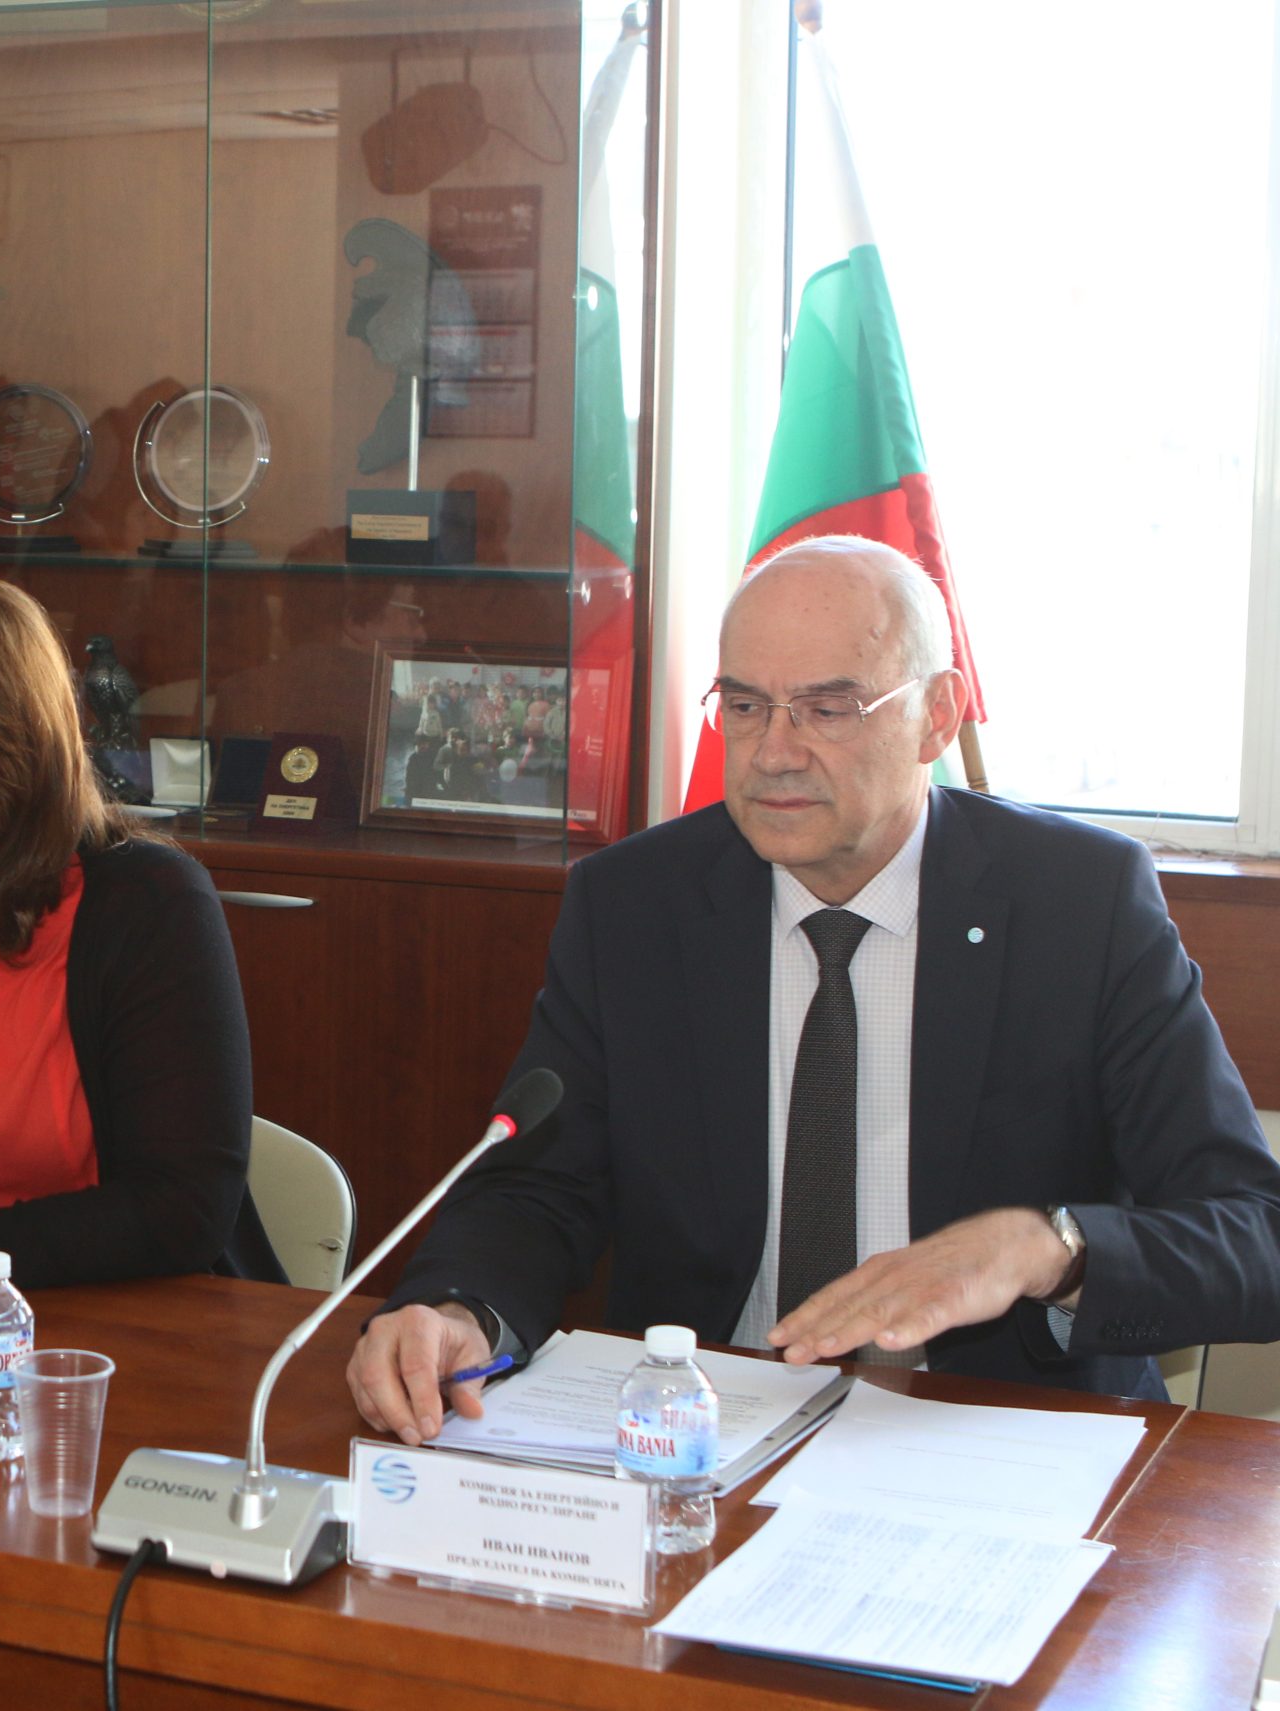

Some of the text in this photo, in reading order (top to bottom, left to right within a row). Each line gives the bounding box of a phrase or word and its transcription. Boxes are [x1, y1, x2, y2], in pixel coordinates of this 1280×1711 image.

[125, 1476, 217, 1502] GONSIN
[459, 1478, 517, 1497] КОМИСИЯ
[520, 1488, 533, 1500] ЗА
[482, 1538, 591, 1566] ИВАН ИВАНОВ
[447, 1553, 627, 1591] ПРЕДСЕДАТЕЛ НА КОМИСИЯТА
